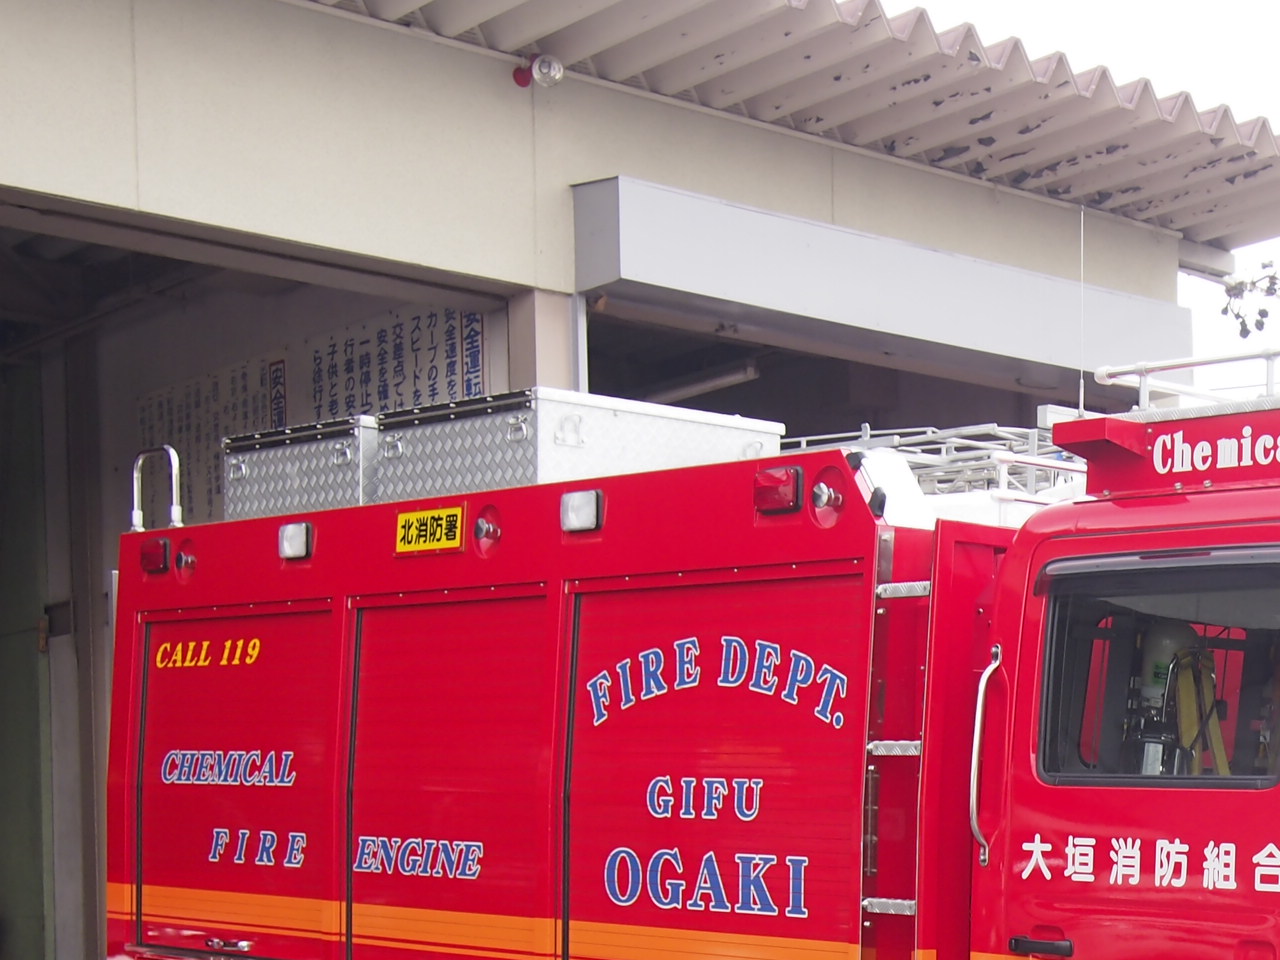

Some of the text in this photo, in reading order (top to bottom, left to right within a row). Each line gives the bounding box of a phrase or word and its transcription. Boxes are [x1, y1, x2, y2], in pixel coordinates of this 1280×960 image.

[343, 338, 356, 417] 行者の安
[400, 513, 458, 546] 北消防署
[156, 637, 260, 668] CALL 119
[587, 635, 848, 730] FIRE DEPT.
[160, 749, 297, 787] CHEMICAL
[646, 775, 764, 822] GIFU
[208, 828, 484, 880] FIRE ENGINE
[603, 846, 809, 919] OGAKI
